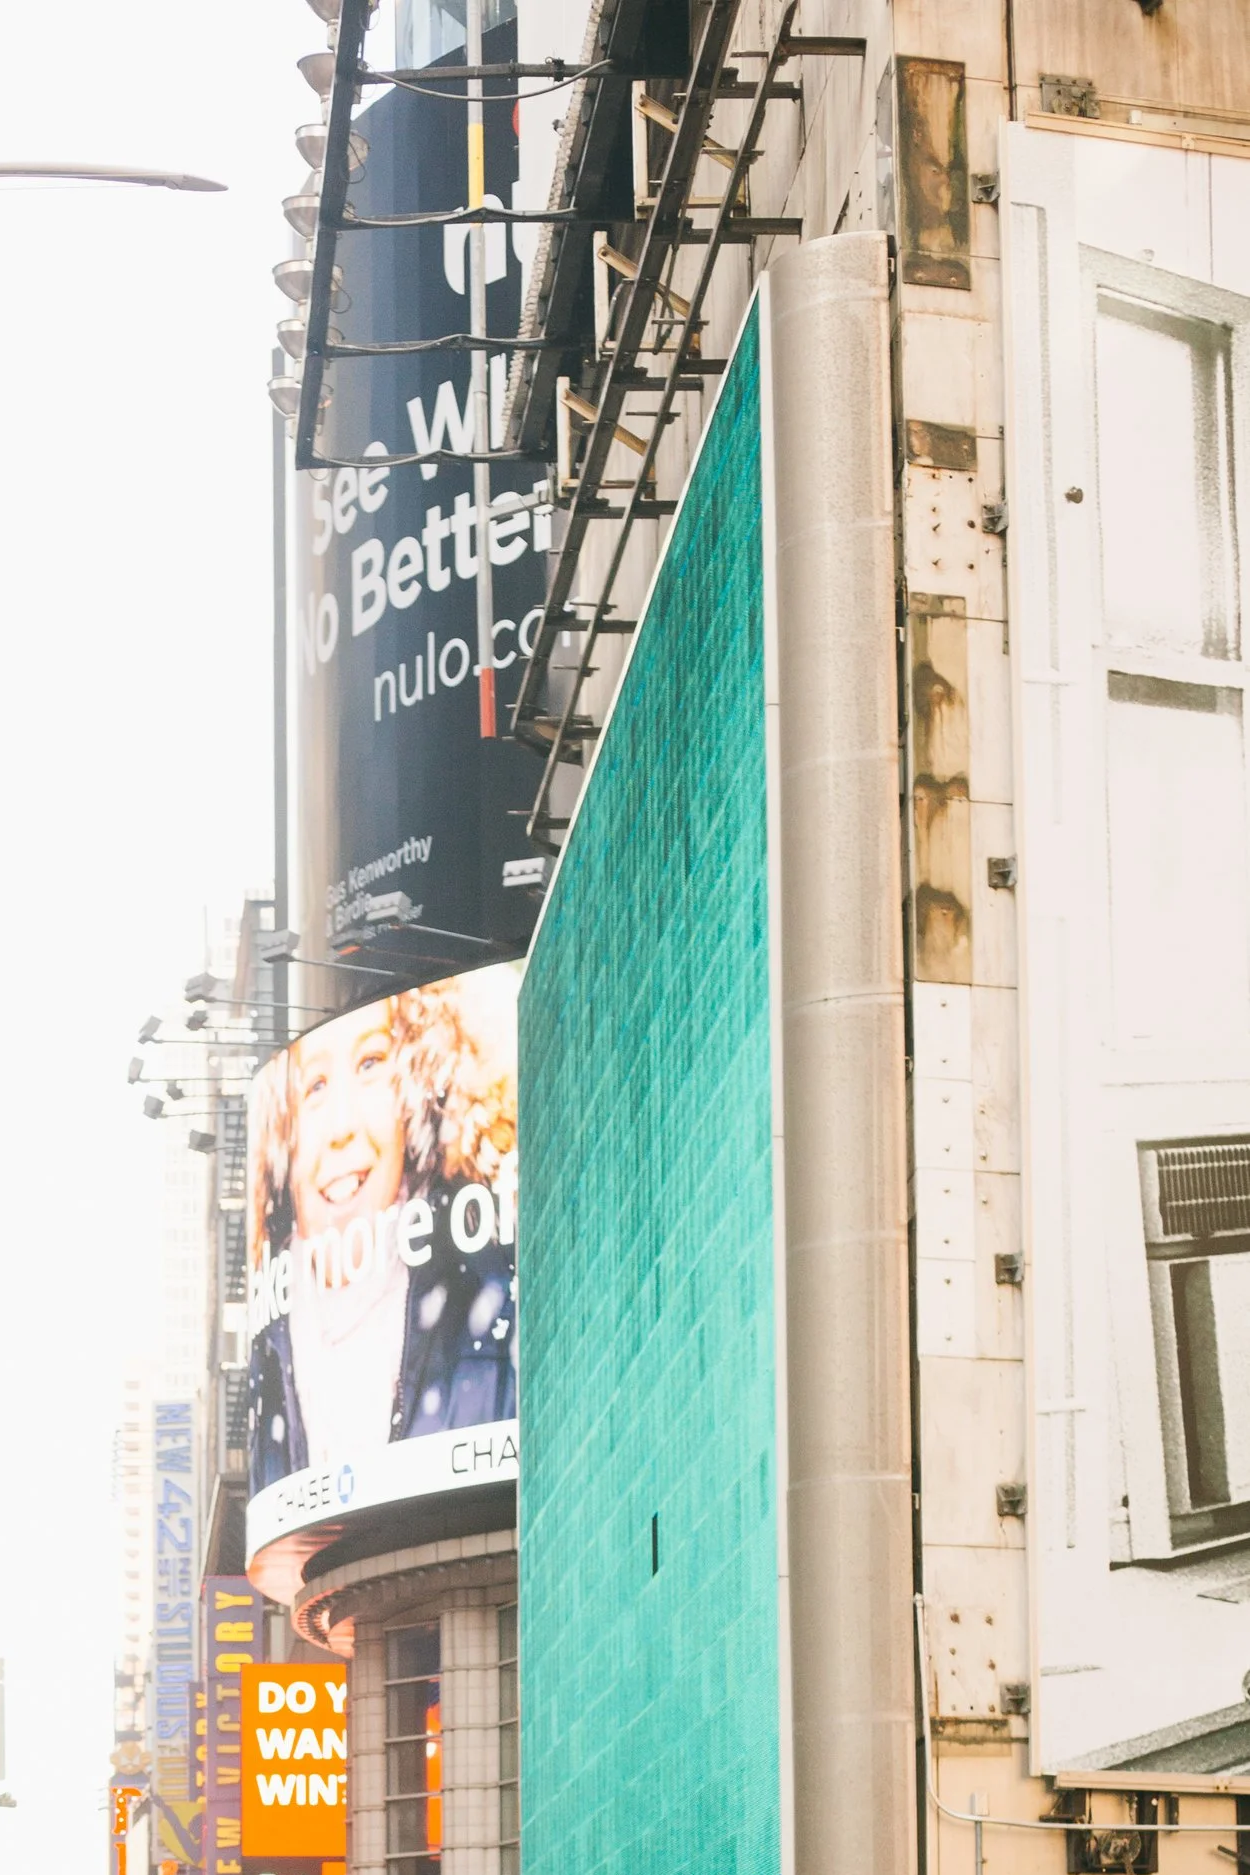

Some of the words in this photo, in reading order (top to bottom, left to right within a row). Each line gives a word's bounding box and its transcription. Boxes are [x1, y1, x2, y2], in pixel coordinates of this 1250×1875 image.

[352, 479, 551, 637] Better
[348, 835, 433, 893] Kenworthy
[300, 1197, 434, 1300] more
[155, 1403, 192, 1473] NEW
[258, 1680, 316, 1714] DO
